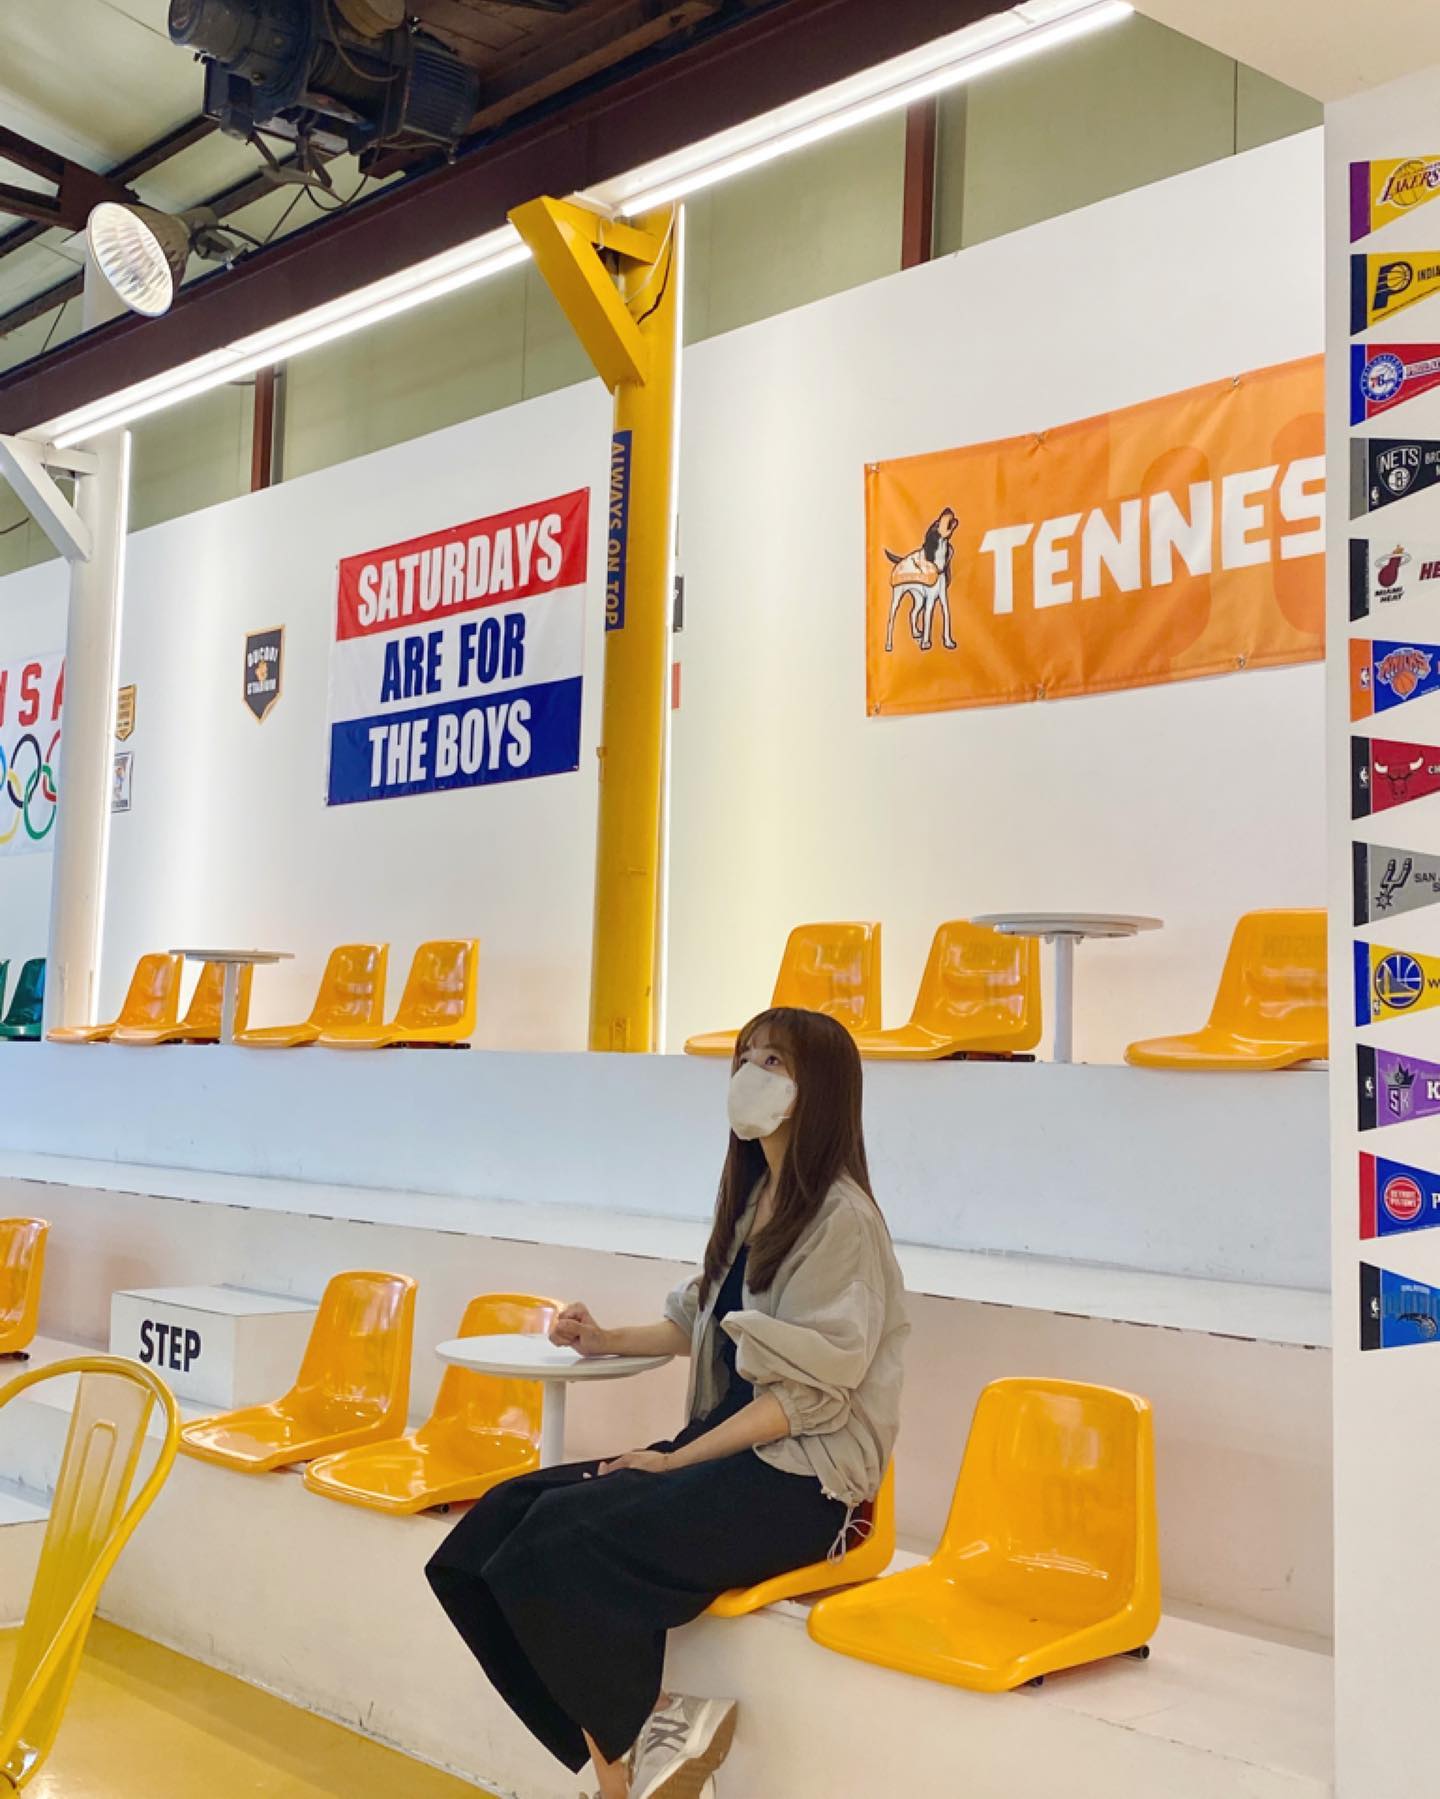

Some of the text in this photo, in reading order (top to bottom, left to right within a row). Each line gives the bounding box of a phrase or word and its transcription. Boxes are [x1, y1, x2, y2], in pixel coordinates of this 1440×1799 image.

[1379, 447, 1419, 474] NETS
[357, 513, 563, 627] SATURDAYS
[979, 454, 1326, 615] TENNES
[380, 612, 526, 704] ARE FOR
[368, 699, 532, 788] THE BOYS
[139, 1319, 201, 1373] STEP
